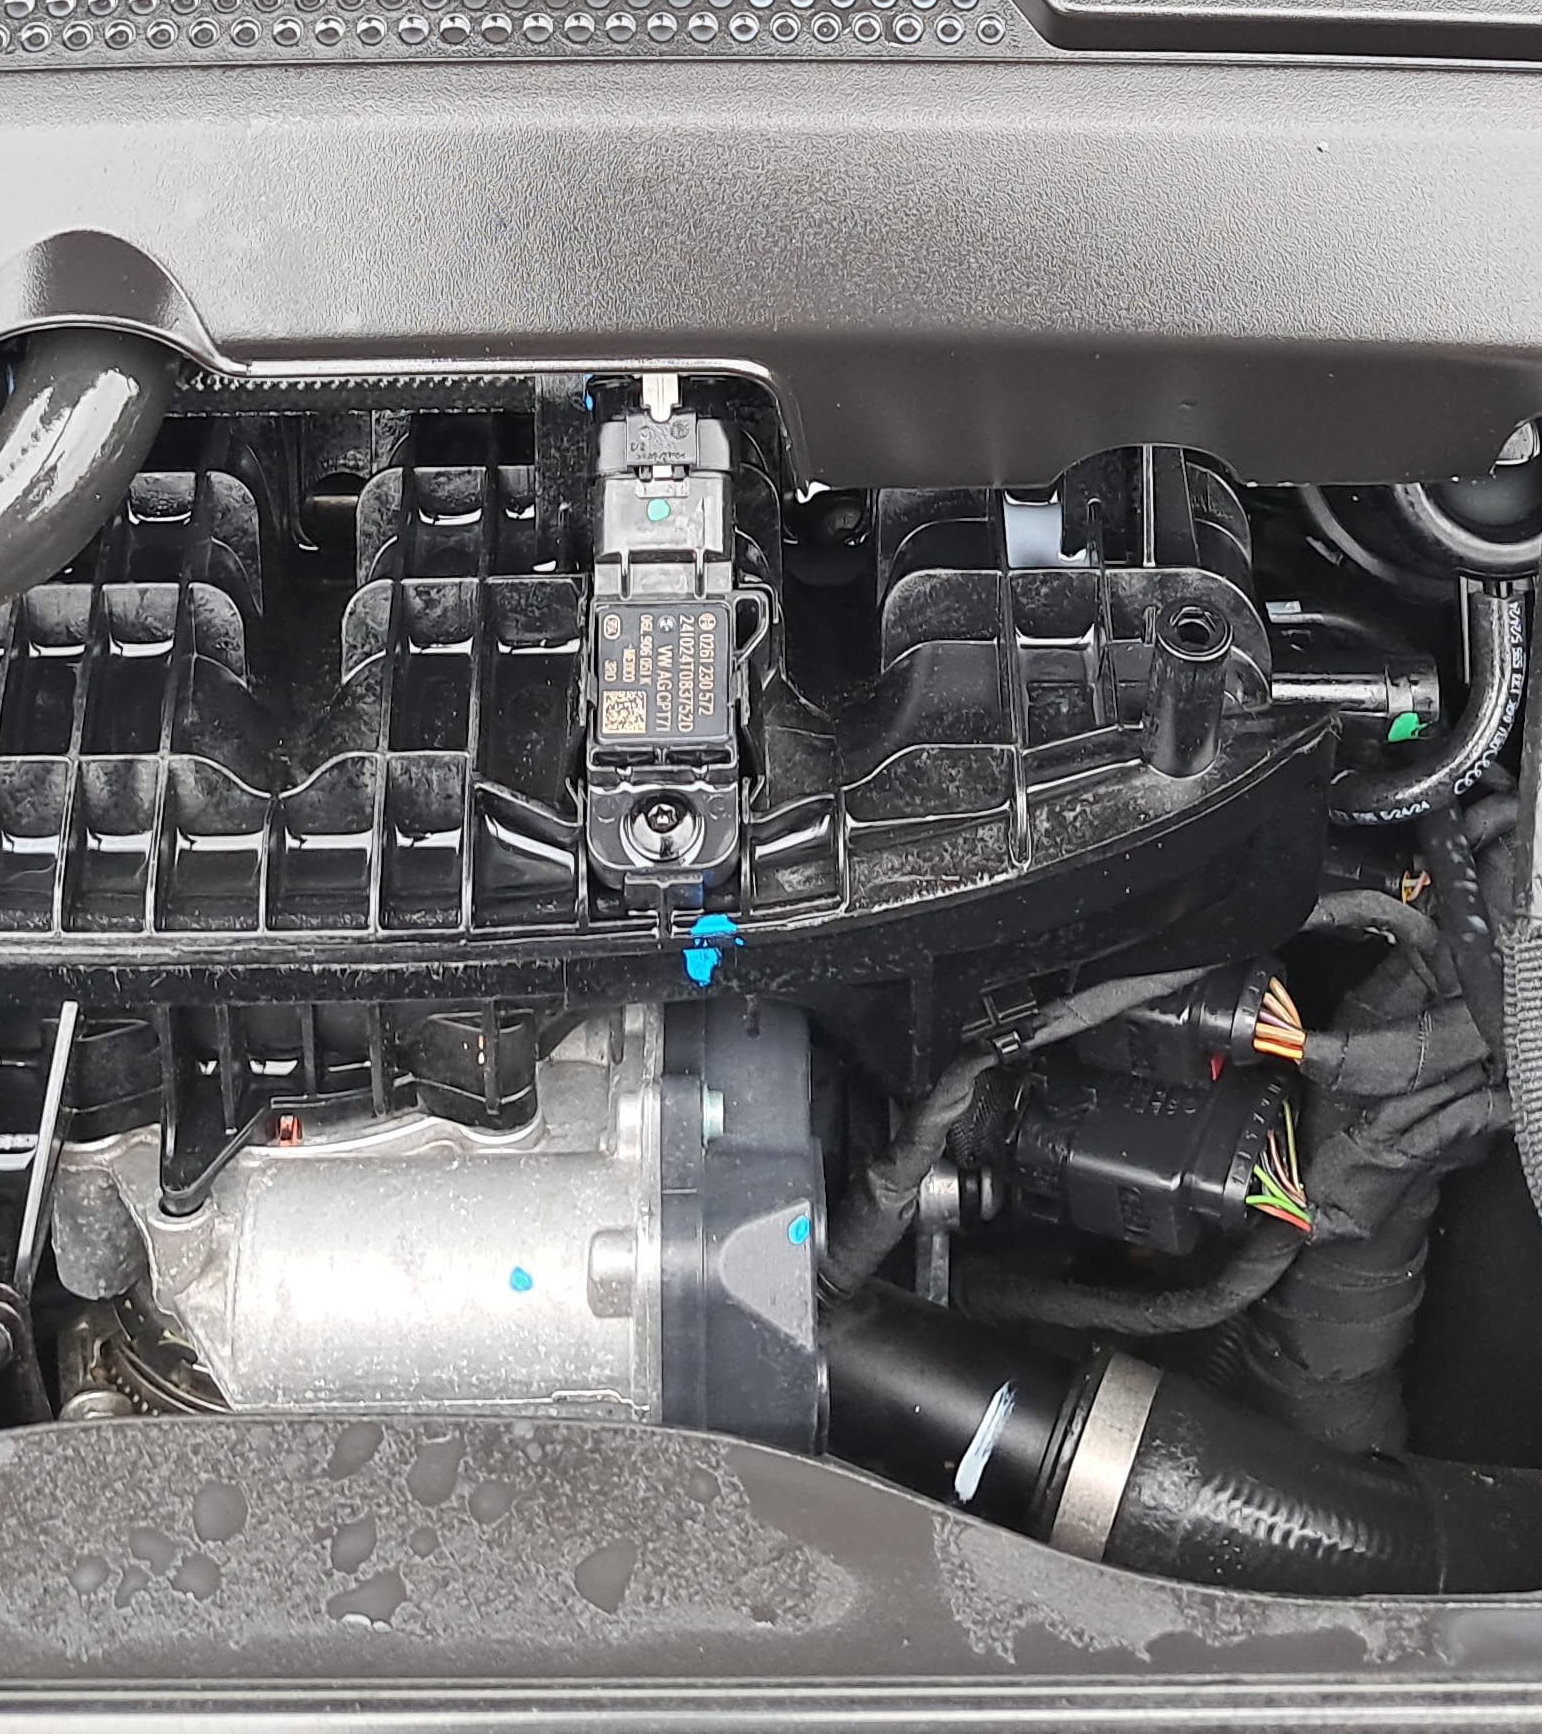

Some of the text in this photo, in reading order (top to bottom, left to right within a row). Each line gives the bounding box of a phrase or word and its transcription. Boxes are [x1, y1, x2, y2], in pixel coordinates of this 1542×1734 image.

[1508, 602, 1522, 642] 5/24/24
[657, 644, 672, 666] VW
[656, 670, 672, 690] AG
[698, 633, 714, 715] 0261 230 572
